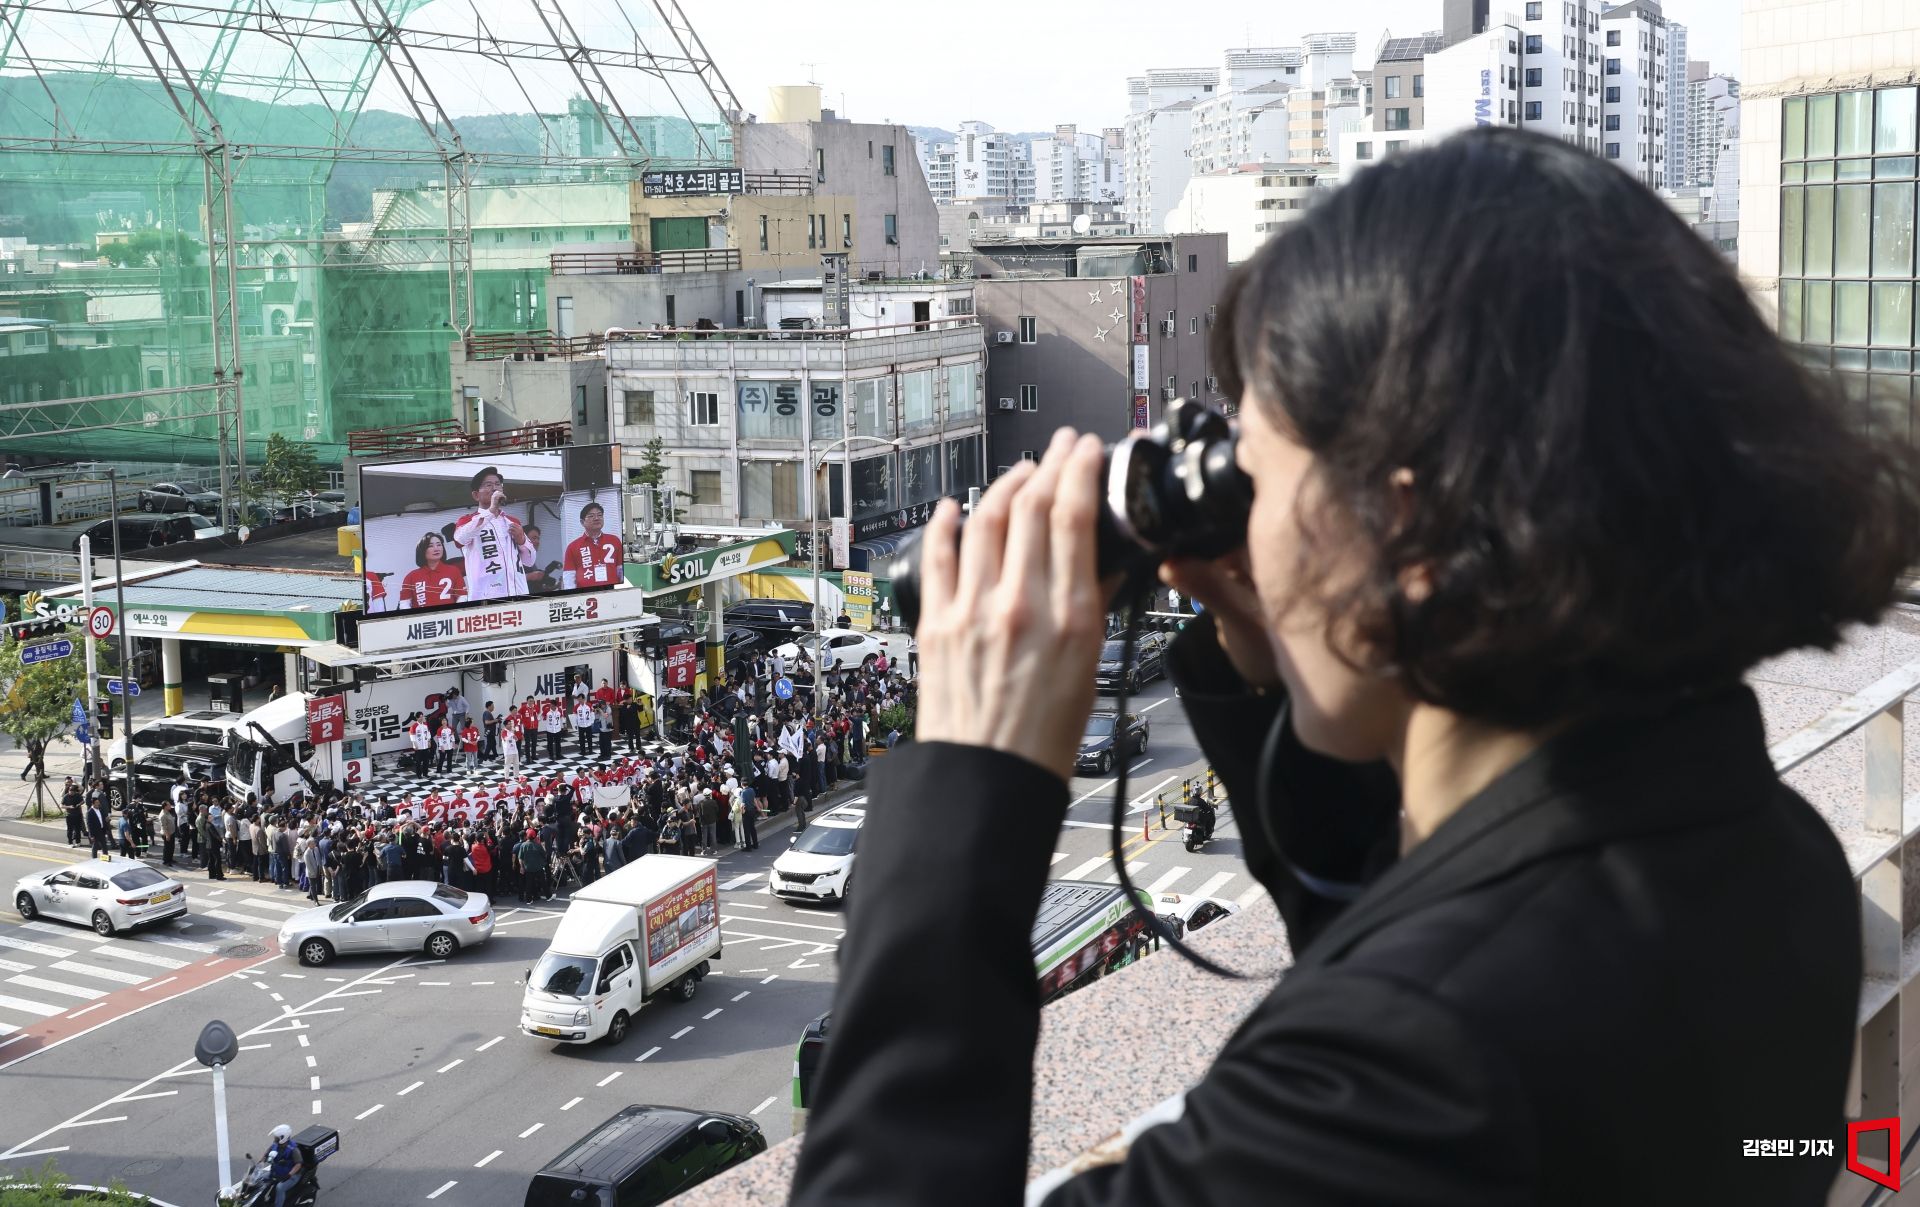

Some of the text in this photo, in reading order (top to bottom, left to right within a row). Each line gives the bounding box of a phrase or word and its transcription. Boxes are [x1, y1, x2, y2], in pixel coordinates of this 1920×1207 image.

[480, 529, 502, 575] 김문수
[602, 543, 615, 564] 2
[580, 546, 594, 580] 김문수
[670, 558, 709, 584] S-OIL
[438, 577, 452, 600] 2
[847, 575, 872, 586] 1968
[415, 581, 426, 608] 김문
[847, 586, 872, 596] 1858
[549, 598, 598, 624] 김문수 2
[94, 614, 109, 630] 30
[407, 610, 522, 641] 새롭게 대한민국!
[669, 652, 695, 667] 김문수
[677, 667, 687, 683] 2
[311, 707, 343, 722] 김문수
[355, 705, 390, 719] 정정당당
[322, 722, 334, 739] 2
[347, 761, 361, 783] 2
[432, 805, 445, 822] 2
[475, 800, 488, 819] 2
